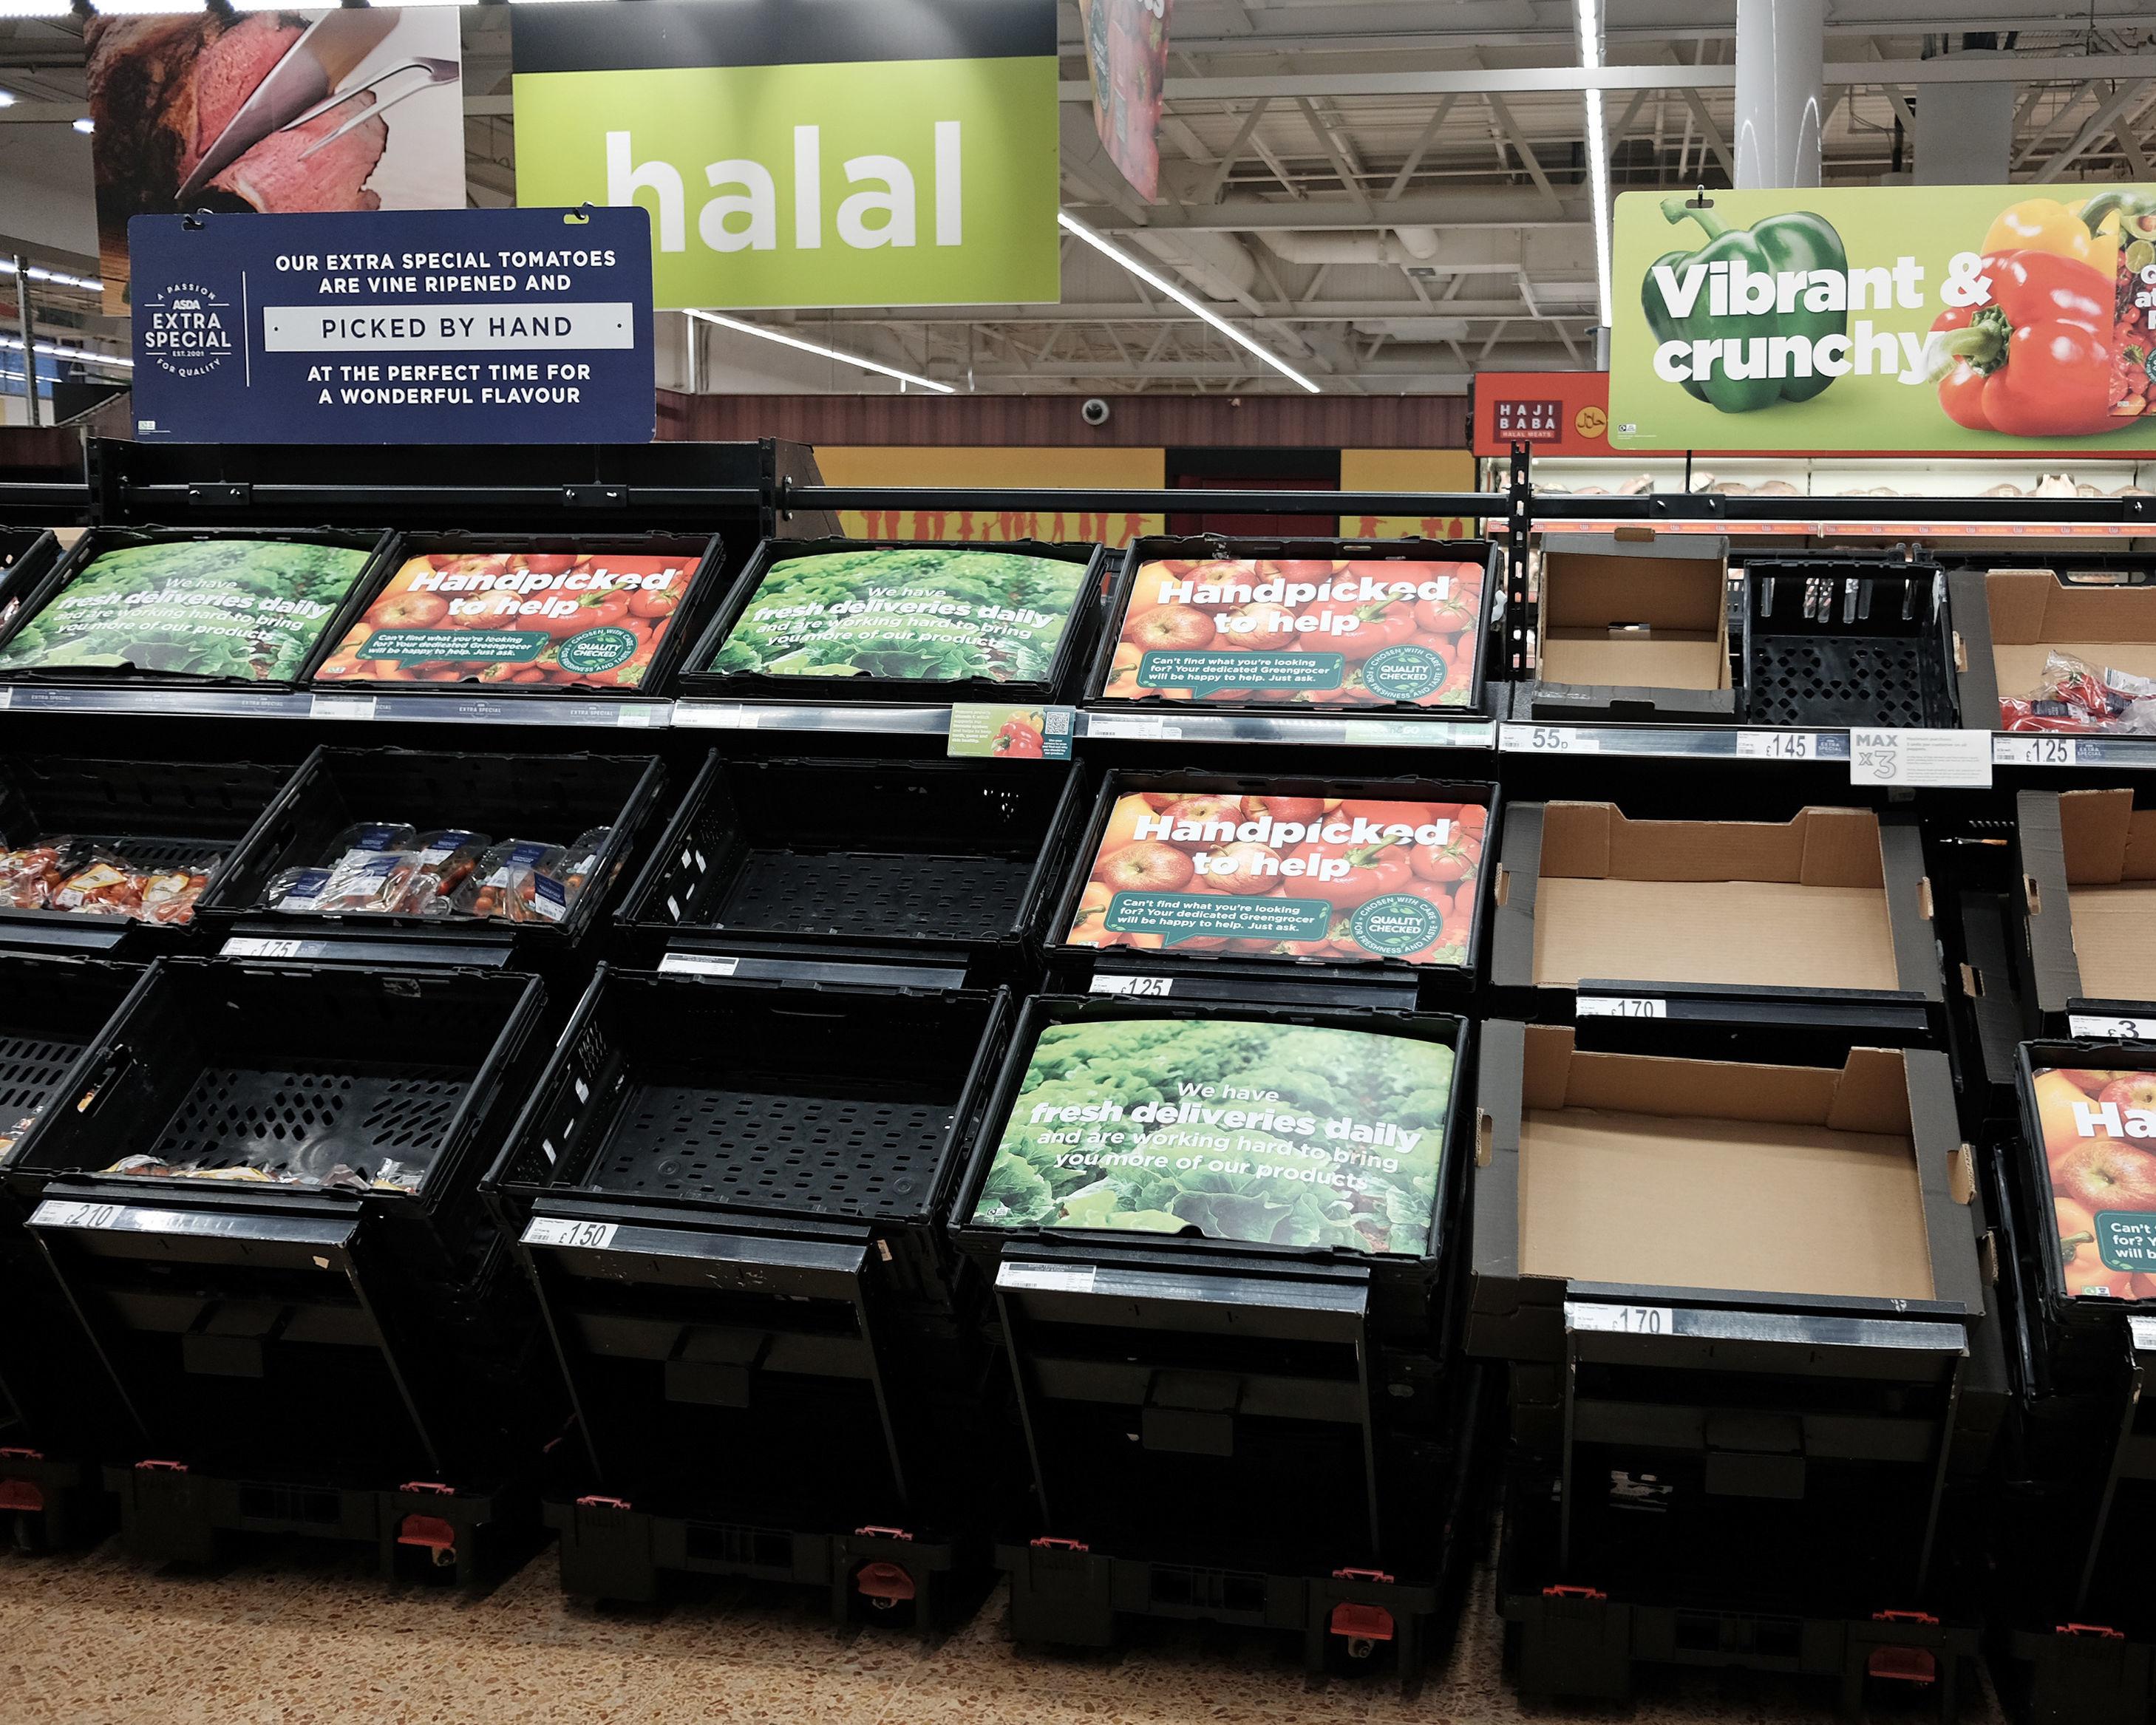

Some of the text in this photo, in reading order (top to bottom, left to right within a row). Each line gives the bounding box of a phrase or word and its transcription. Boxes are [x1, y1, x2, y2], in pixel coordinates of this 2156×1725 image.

[605, 120, 962, 253] halal
[275, 251, 616, 271] OUR EXTRA SPECIAL TOMATOES
[166, 283, 217, 300] PASSION
[319, 275, 571, 293] ARE VINE RIPENED AND
[1650, 252, 1993, 319] Vibrant &
[172, 299, 201, 310] ASDA
[153, 313, 222, 330] EXTRA
[322, 316, 572, 338] PICKED BY HAND
[145, 331, 232, 348] SPECIAL
[1653, 319, 1944, 385] crunchy
[157, 358, 221, 378] FOR QUALITY
[307, 364, 591, 381] AT THE PERFECT TIME FOR
[319, 387, 580, 404] A WONDERFUL FLAVOUR
[1500, 404, 1553, 416] HAJI
[1500, 418, 1555, 429] BABA
[165, 578, 238, 590] We have
[407, 568, 678, 594] Handpicked
[868, 587, 947, 598] We have
[1157, 576, 1451, 608] Handpicked
[56, 590, 332, 621] fresh deliveries daily
[447, 596, 579, 619] to help
[752, 599, 1055, 629] fresh deliveries daily
[756, 616, 1032, 640] and are working hard to bring
[1214, 610, 1360, 636] to help
[577, 642, 622, 651] QUALITY
[766, 629, 1007, 650] you more of our products
[573, 650, 616, 658] CHECKED
[1152, 657, 1182, 665] Can't
[1183, 657, 1205, 665] find
[1237, 659, 1271, 667] you're
[1274, 659, 1316, 667] looking
[1150, 664, 1330, 676] for? Your dedicated Greengrocer
[1187, 673, 1221, 682] happy
[1238, 674, 1265, 682] help.
[1379, 673, 1428, 681] CHECKED
[1381, 665, 1429, 673] QUALITY
[1856, 734, 1898, 746] MAX
[1132, 815, 1450, 848] Handpicked
[1192, 851, 1352, 882] to help
[1120, 907, 1315, 925] for? Your dedicated Greengrocer
[1123, 899, 1300, 916] Can't find what you're looking
[1360, 896, 1437, 920] CHOSEN WITH CARE
[1117, 916, 1300, 932] will be happy to help. Just ask.
[1369, 924, 1421, 934] CHECKED
[1370, 916, 1424, 926] QUALITY
[1354, 922, 1438, 953] FOR FRESHNESS AND TASTE
[1177, 1082, 1279, 1103] We have
[1030, 1100, 1423, 1154] fresh deliveries daily
[1037, 1129, 1399, 1174] and are working hard to bring
[1053, 1153, 1369, 1191] you more of our products
[2111, 1222, 2151, 1234] Can't
[2112, 1234, 2143, 1246] for?
[2115, 1248, 2143, 1259] will
